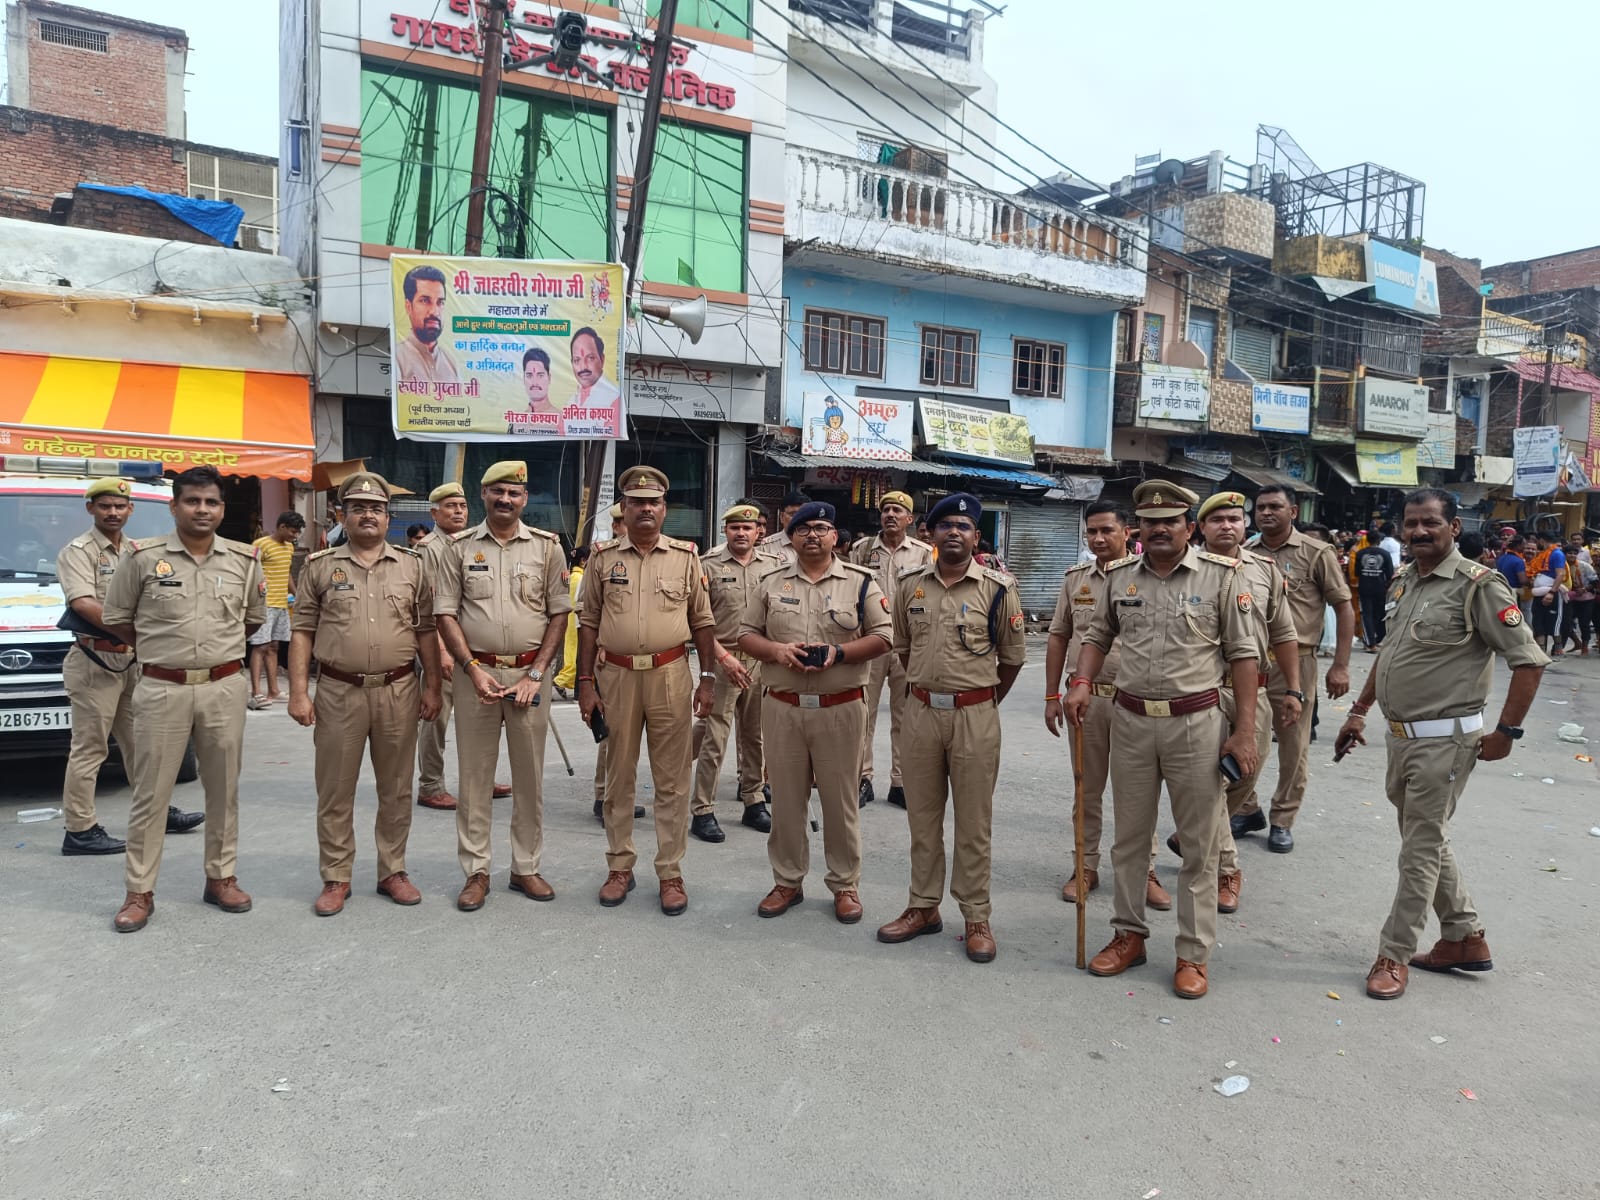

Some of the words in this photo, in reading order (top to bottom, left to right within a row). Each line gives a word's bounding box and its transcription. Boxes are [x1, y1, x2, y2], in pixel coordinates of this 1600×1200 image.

[1375, 261, 1415, 288] LUMINOUS
[453, 270, 470, 295] श्री
[473, 272, 528, 297] जाहरवीर
[531, 273, 563, 298] गोगा
[565, 274, 584, 299] जी
[488, 304, 520, 316] महाराज
[522, 304, 538, 317] मेले
[539, 304, 549, 317] में
[455, 340, 467, 351] का
[470, 338, 498, 352] हार्दिक
[466, 361, 473, 371] व
[432, 381, 461, 400] गुप्ता
[464, 377, 480, 397] जी
[1370, 393, 1409, 411] AMARON
[504, 411, 528, 423] नीरज
[530, 414, 558, 424] कश्यप
[562, 404, 587, 421] अनिल
[589, 408, 614, 422] कश्यप
[23, 434, 96, 458] महेन्द्र
[103, 443, 184, 463] जनरल
[189, 446, 239, 466] स्टोर
[0, 711, 70, 727] 2BG7511
